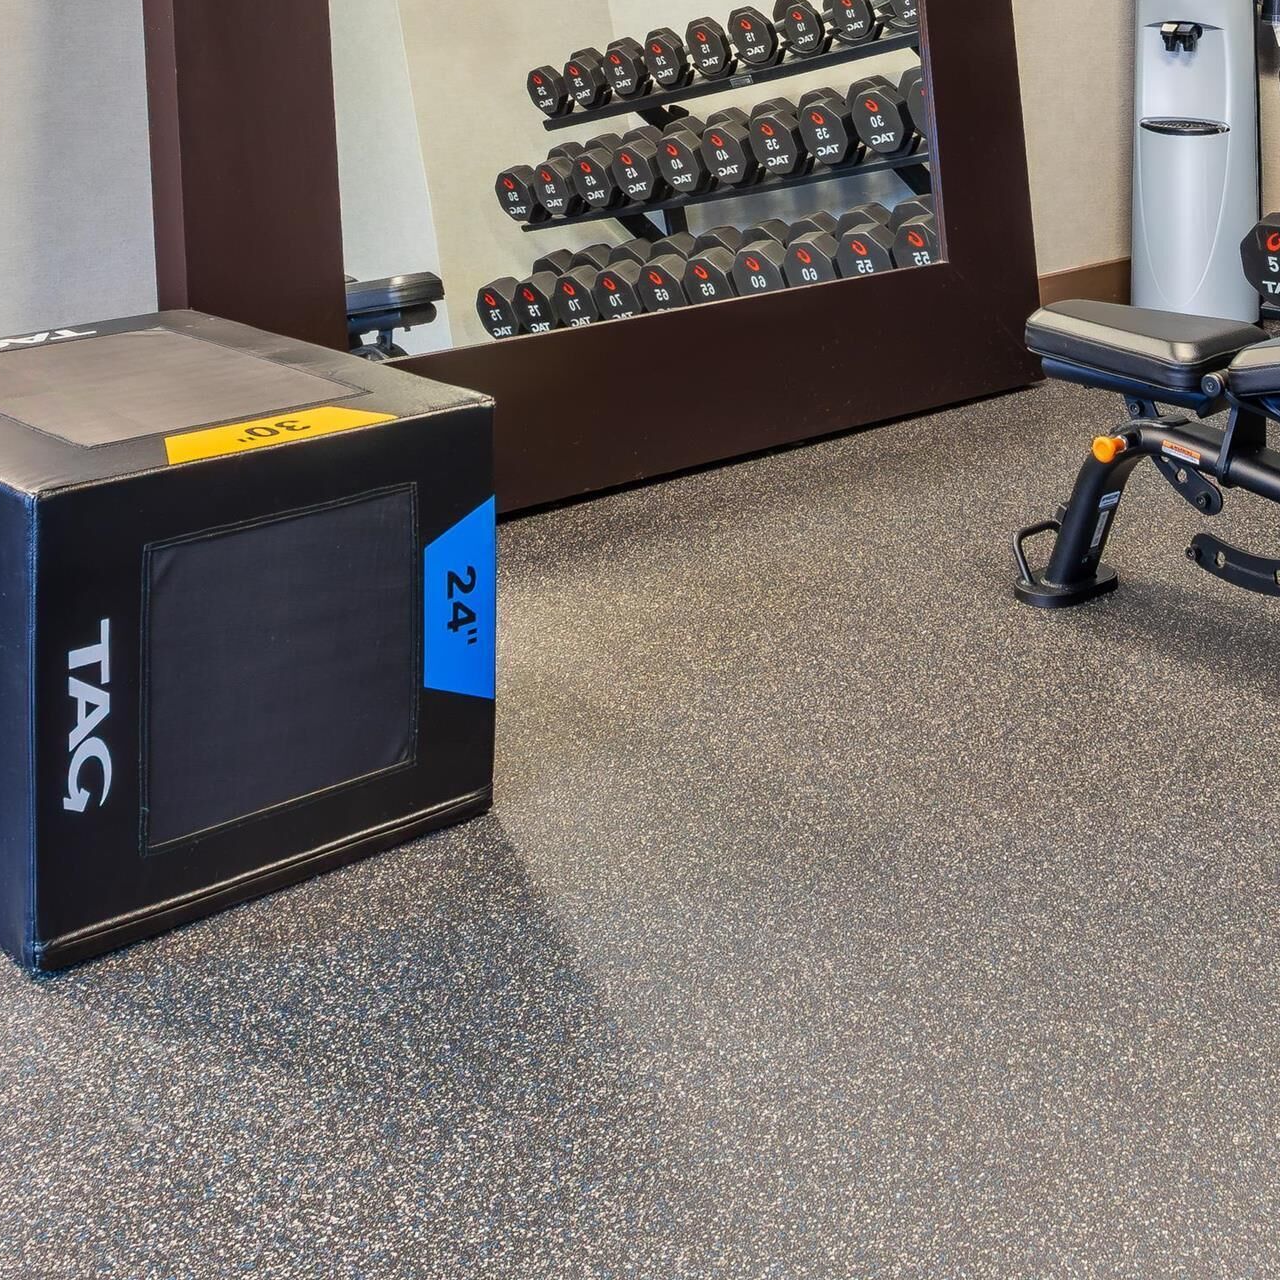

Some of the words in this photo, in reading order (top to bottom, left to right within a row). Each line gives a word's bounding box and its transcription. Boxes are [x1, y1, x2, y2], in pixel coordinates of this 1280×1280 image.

[238, 419, 312, 443] 30"
[446, 565, 479, 647] 24"
[63, 618, 113, 814] TAG
